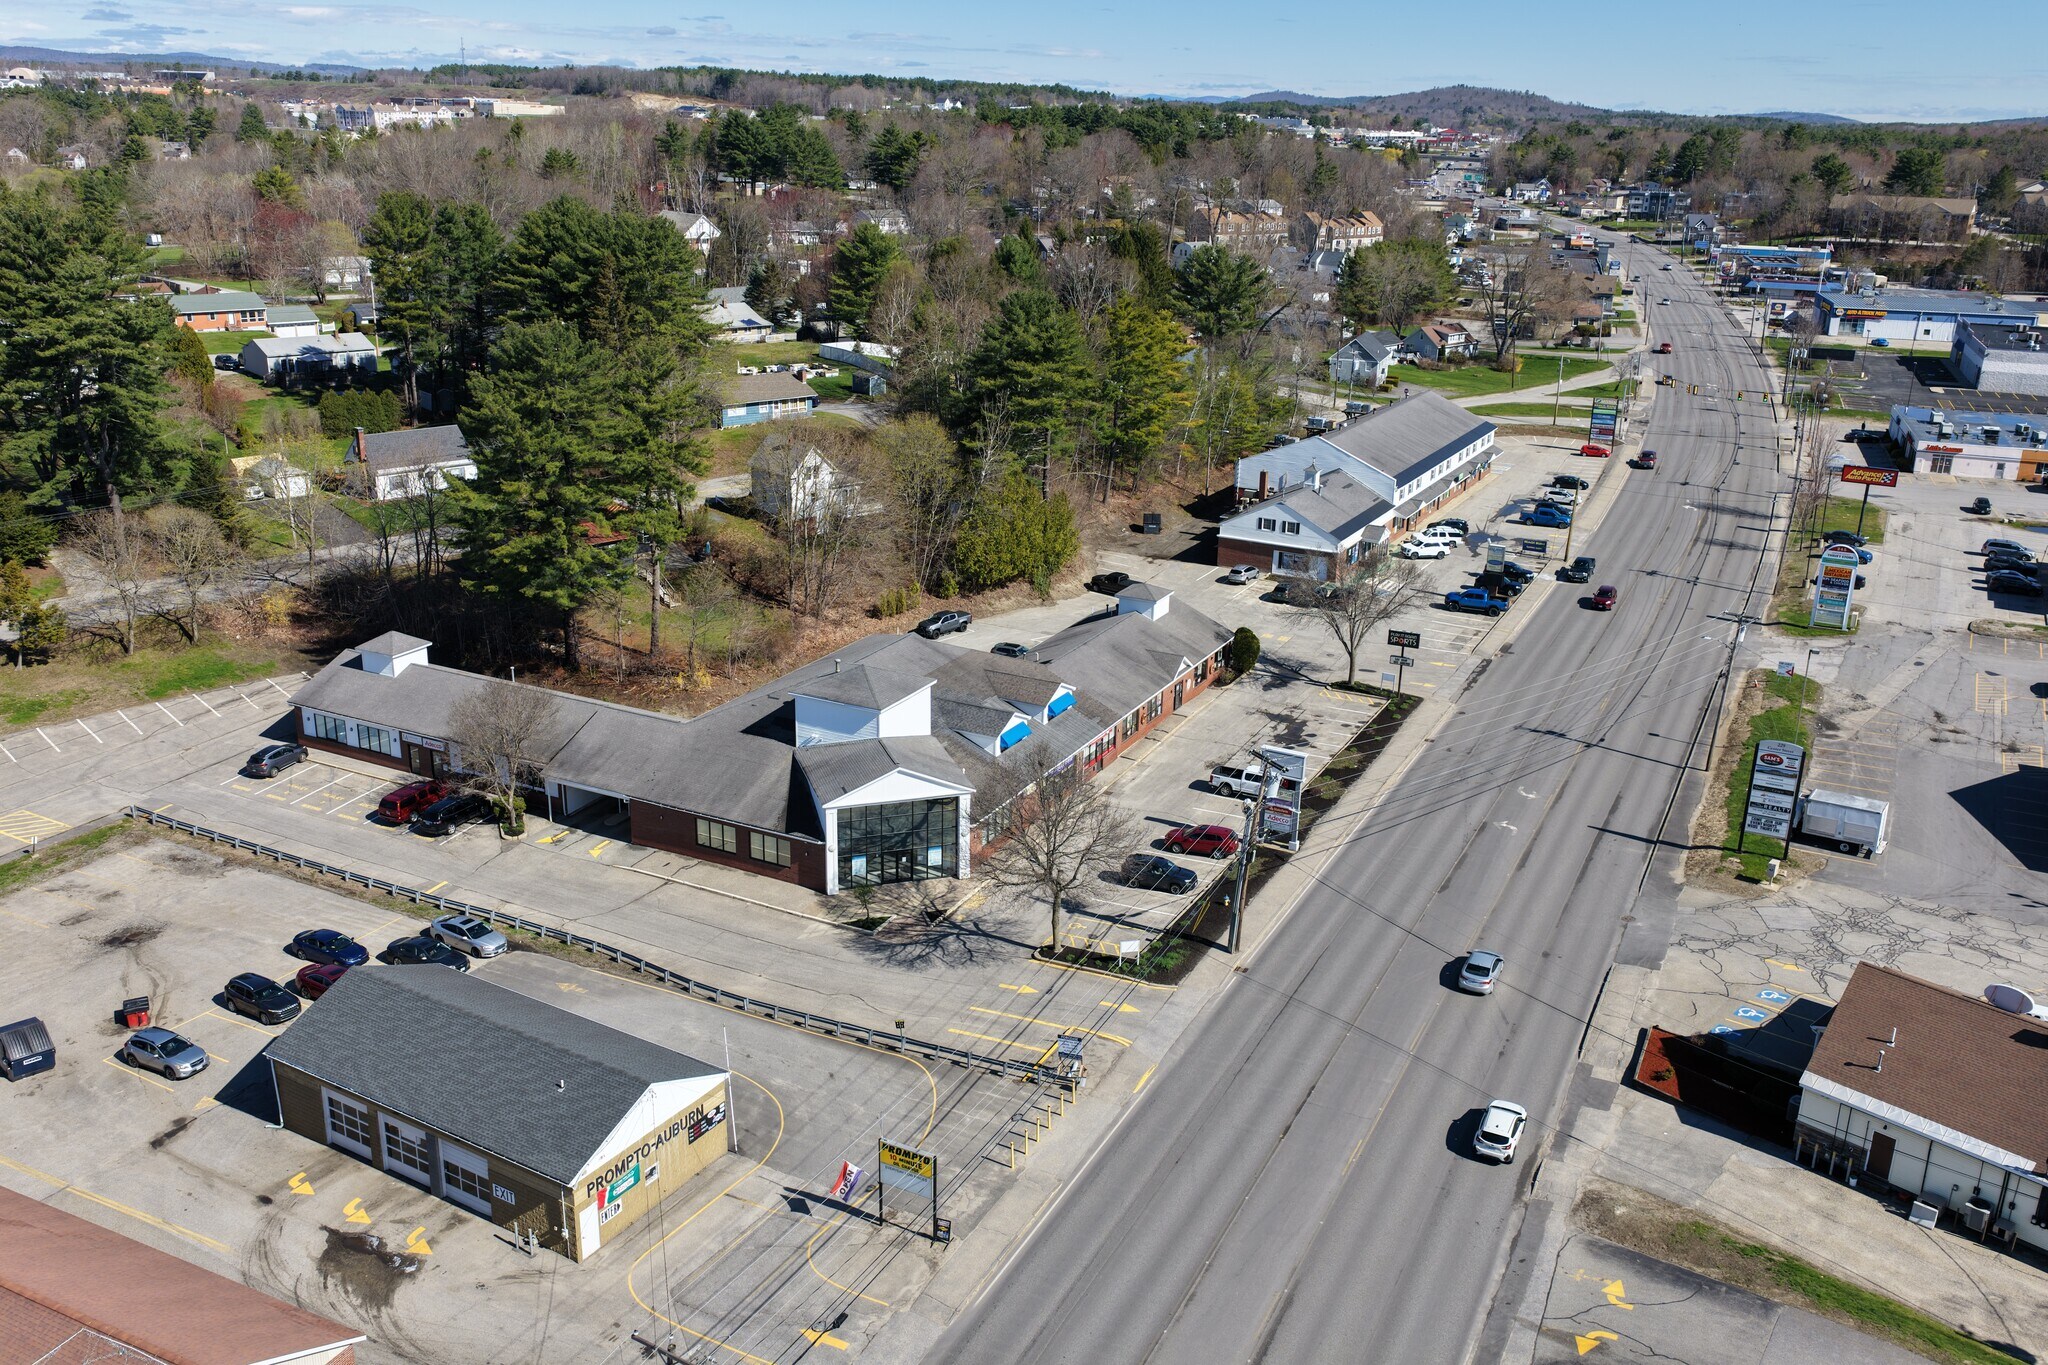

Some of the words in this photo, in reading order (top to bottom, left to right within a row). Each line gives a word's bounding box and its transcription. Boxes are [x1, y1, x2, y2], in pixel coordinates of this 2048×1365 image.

[1850, 469, 1881, 478] Advance
[1390, 637, 1417, 646] SPORTS
[1764, 804, 1790, 812] REALTY
[1267, 814, 1289, 825] Adecco
[586, 1104, 704, 1198] PROMPTO-AUBURN
[882, 1143, 931, 1165] PROMPTO
[889, 1153, 897, 1161] 10
[898, 1157, 923, 1170] MINUTE
[840, 1169, 855, 1195] OPEN
[494, 1185, 514, 1203] EXIT
[601, 1203, 617, 1224] ENTER
